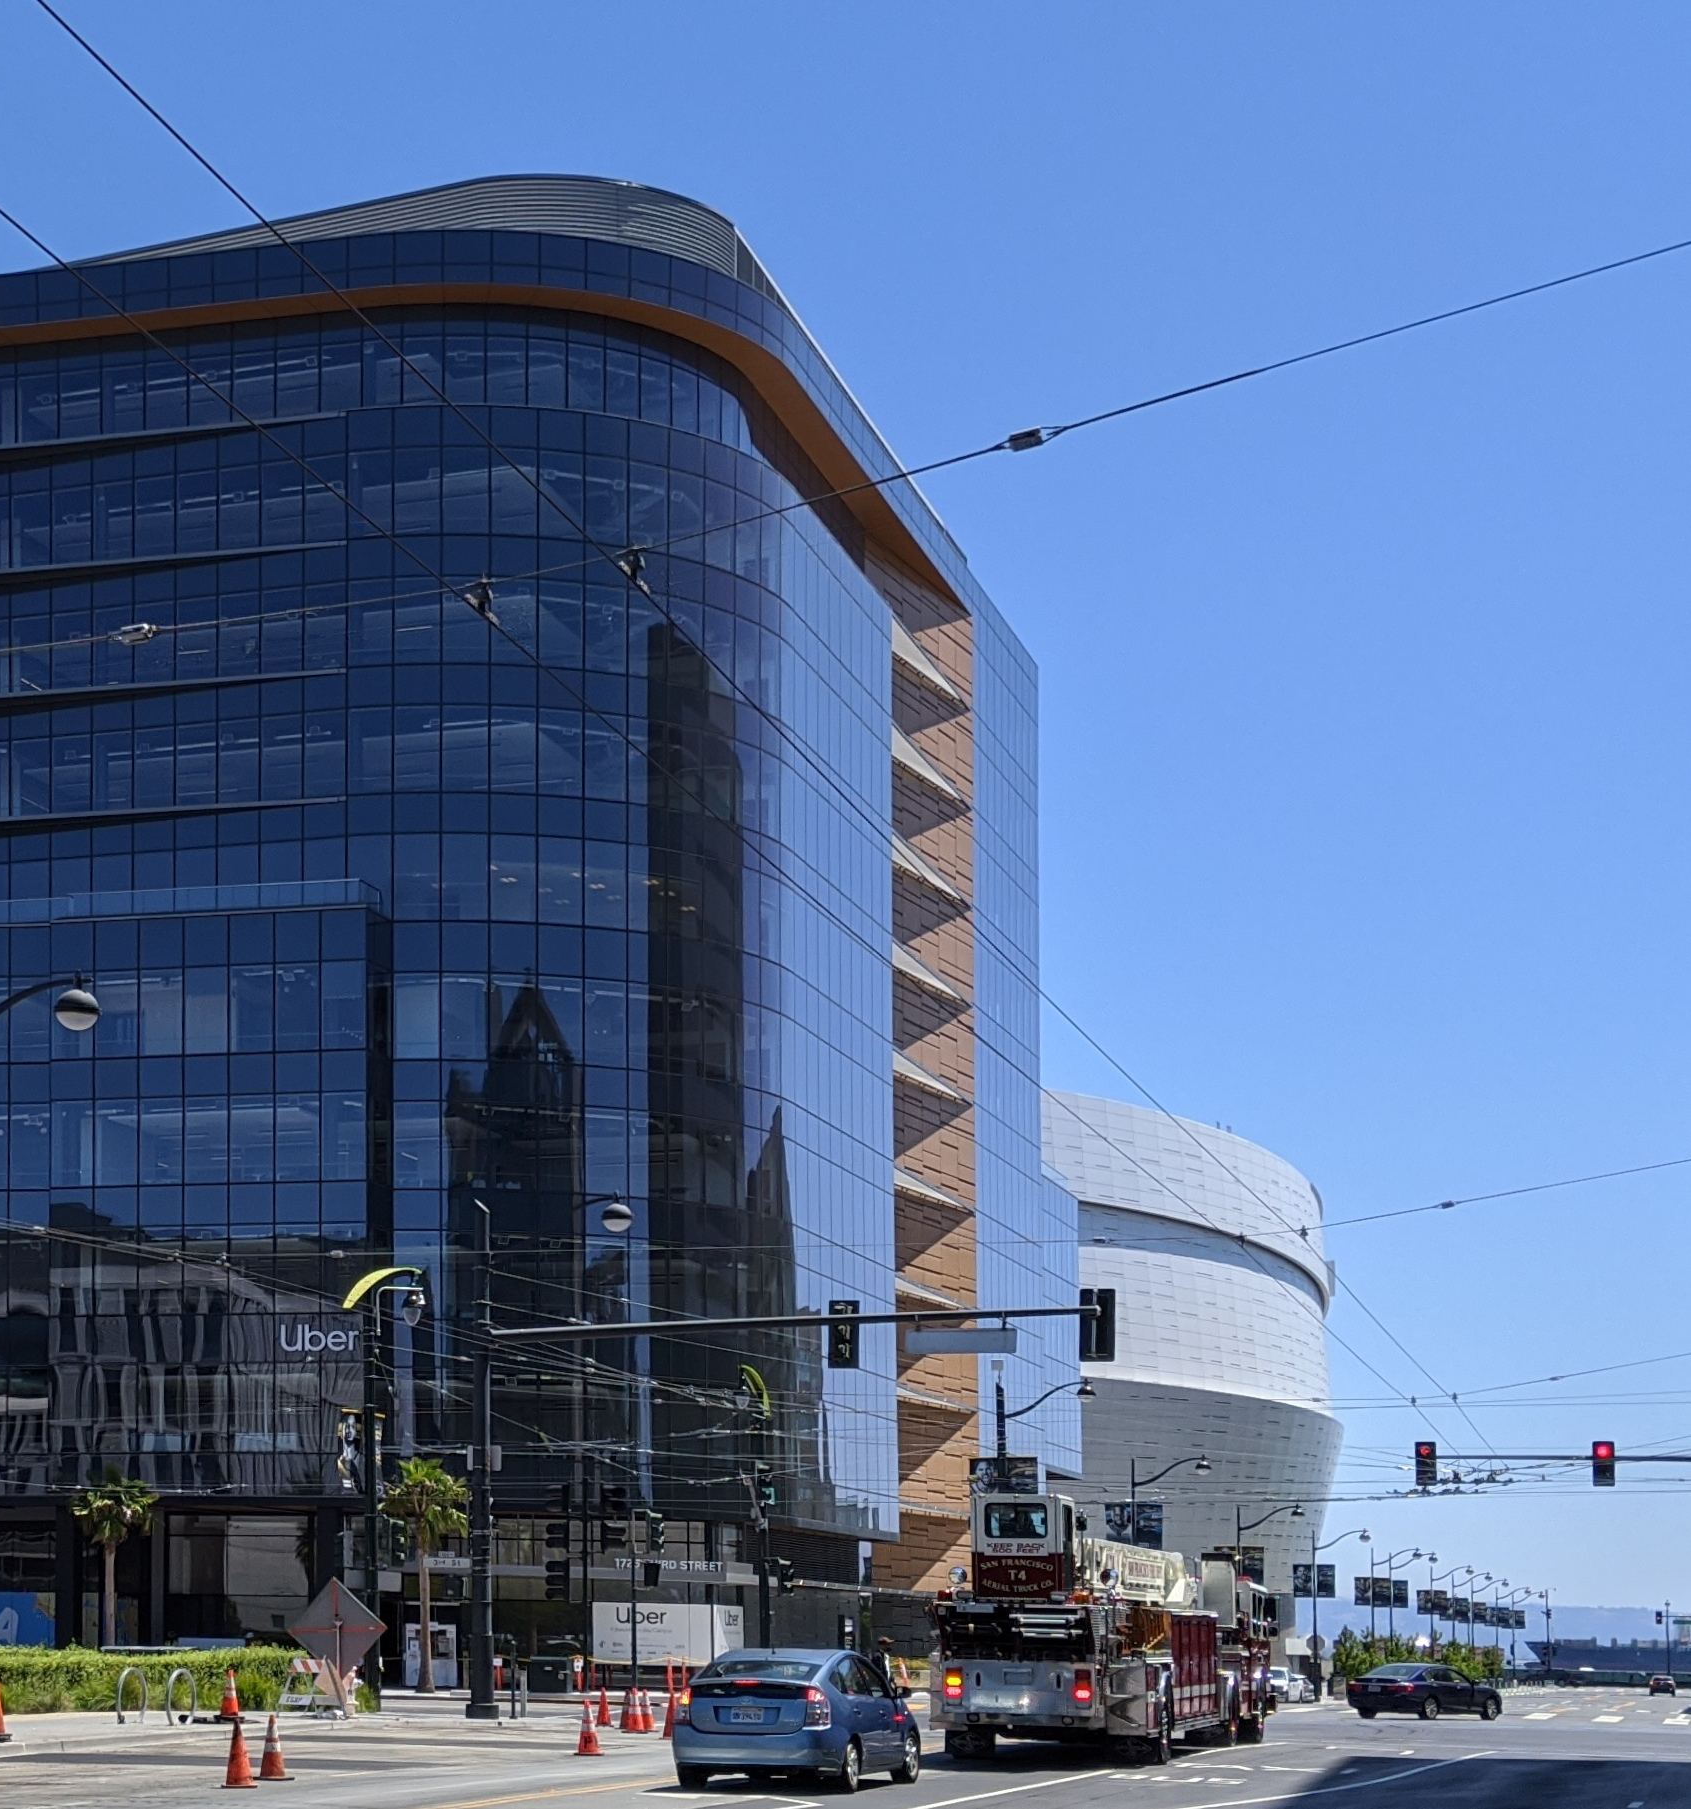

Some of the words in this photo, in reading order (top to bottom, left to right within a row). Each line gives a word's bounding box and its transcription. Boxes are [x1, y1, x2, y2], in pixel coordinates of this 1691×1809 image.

[280, 1324, 359, 1352] Uber
[679, 1560, 723, 1572] STREET
[980, 1560, 999, 1570] SAN
[1001, 1558, 1054, 1572] FRANCISCO
[1008, 1569, 1027, 1581] T4
[981, 1578, 1011, 1592] AERIAL
[1013, 1584, 1040, 1593] TRUCK
[1040, 1579, 1054, 1589] CO.
[724, 1609, 740, 1627] Uber
